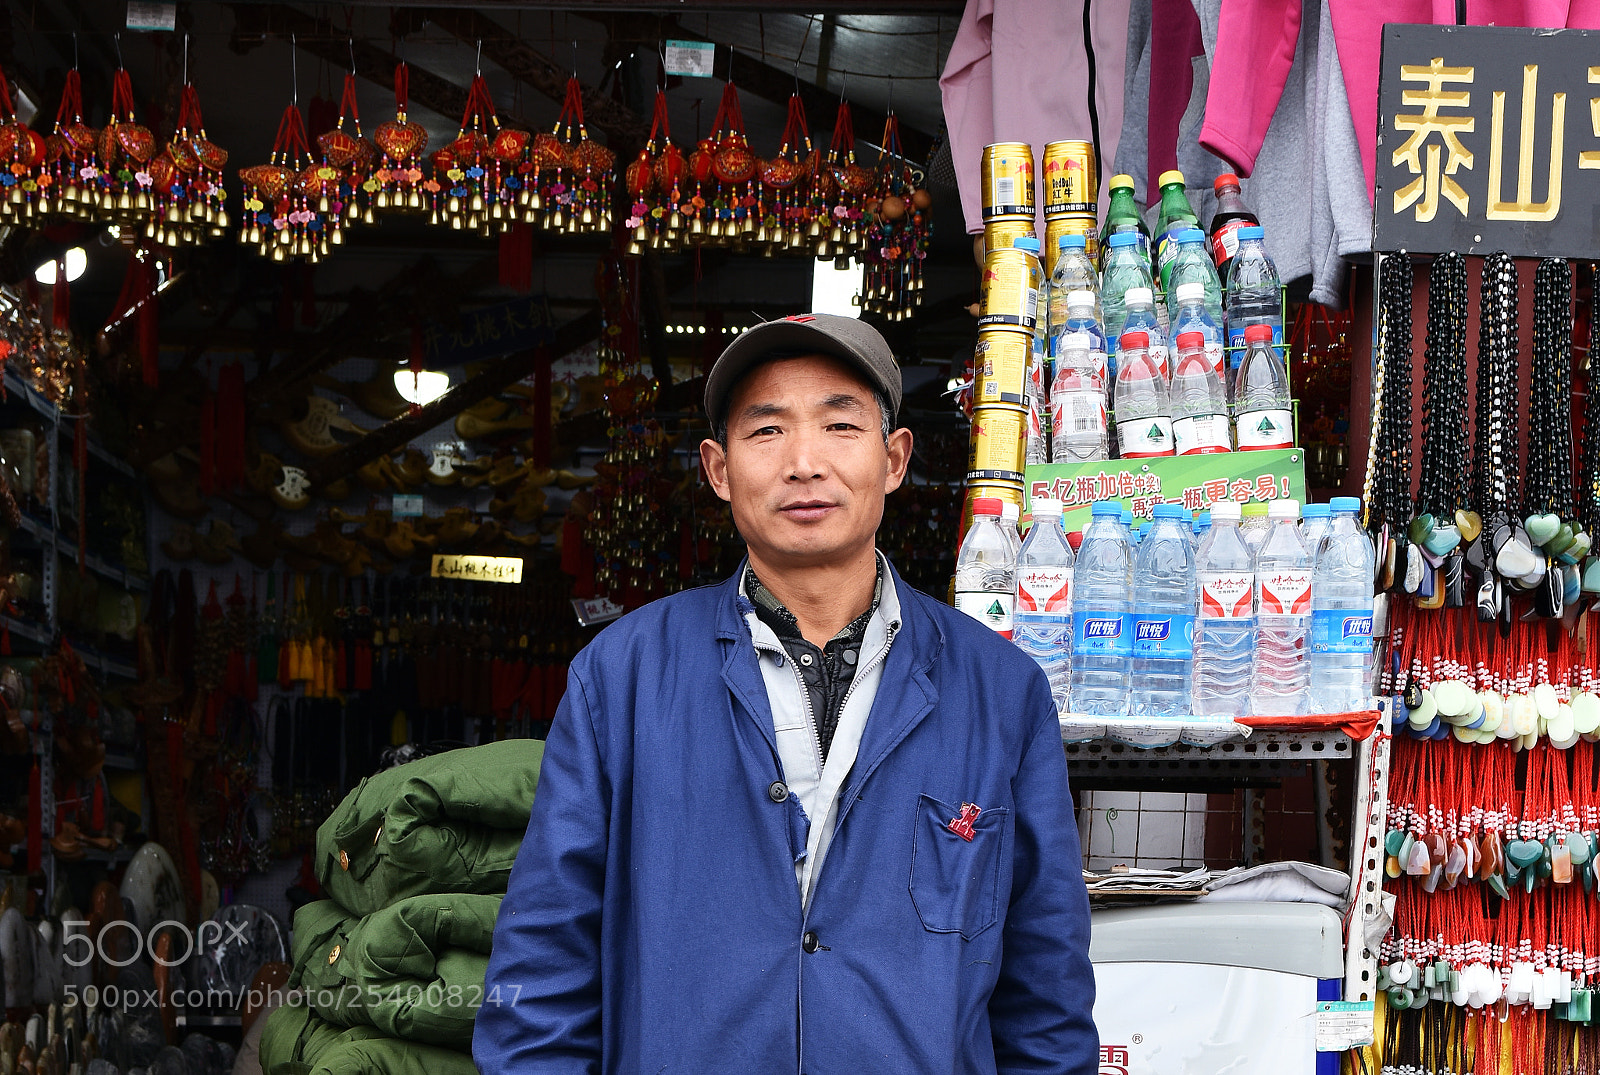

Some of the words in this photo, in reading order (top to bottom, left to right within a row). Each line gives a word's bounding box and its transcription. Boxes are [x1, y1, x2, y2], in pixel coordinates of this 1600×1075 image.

[1052, 188, 1073, 198] 红牛
[1089, 621, 1117, 635] 优悦
[1139, 624, 1164, 637] 优悦
[1349, 619, 1371, 634] 优悦
